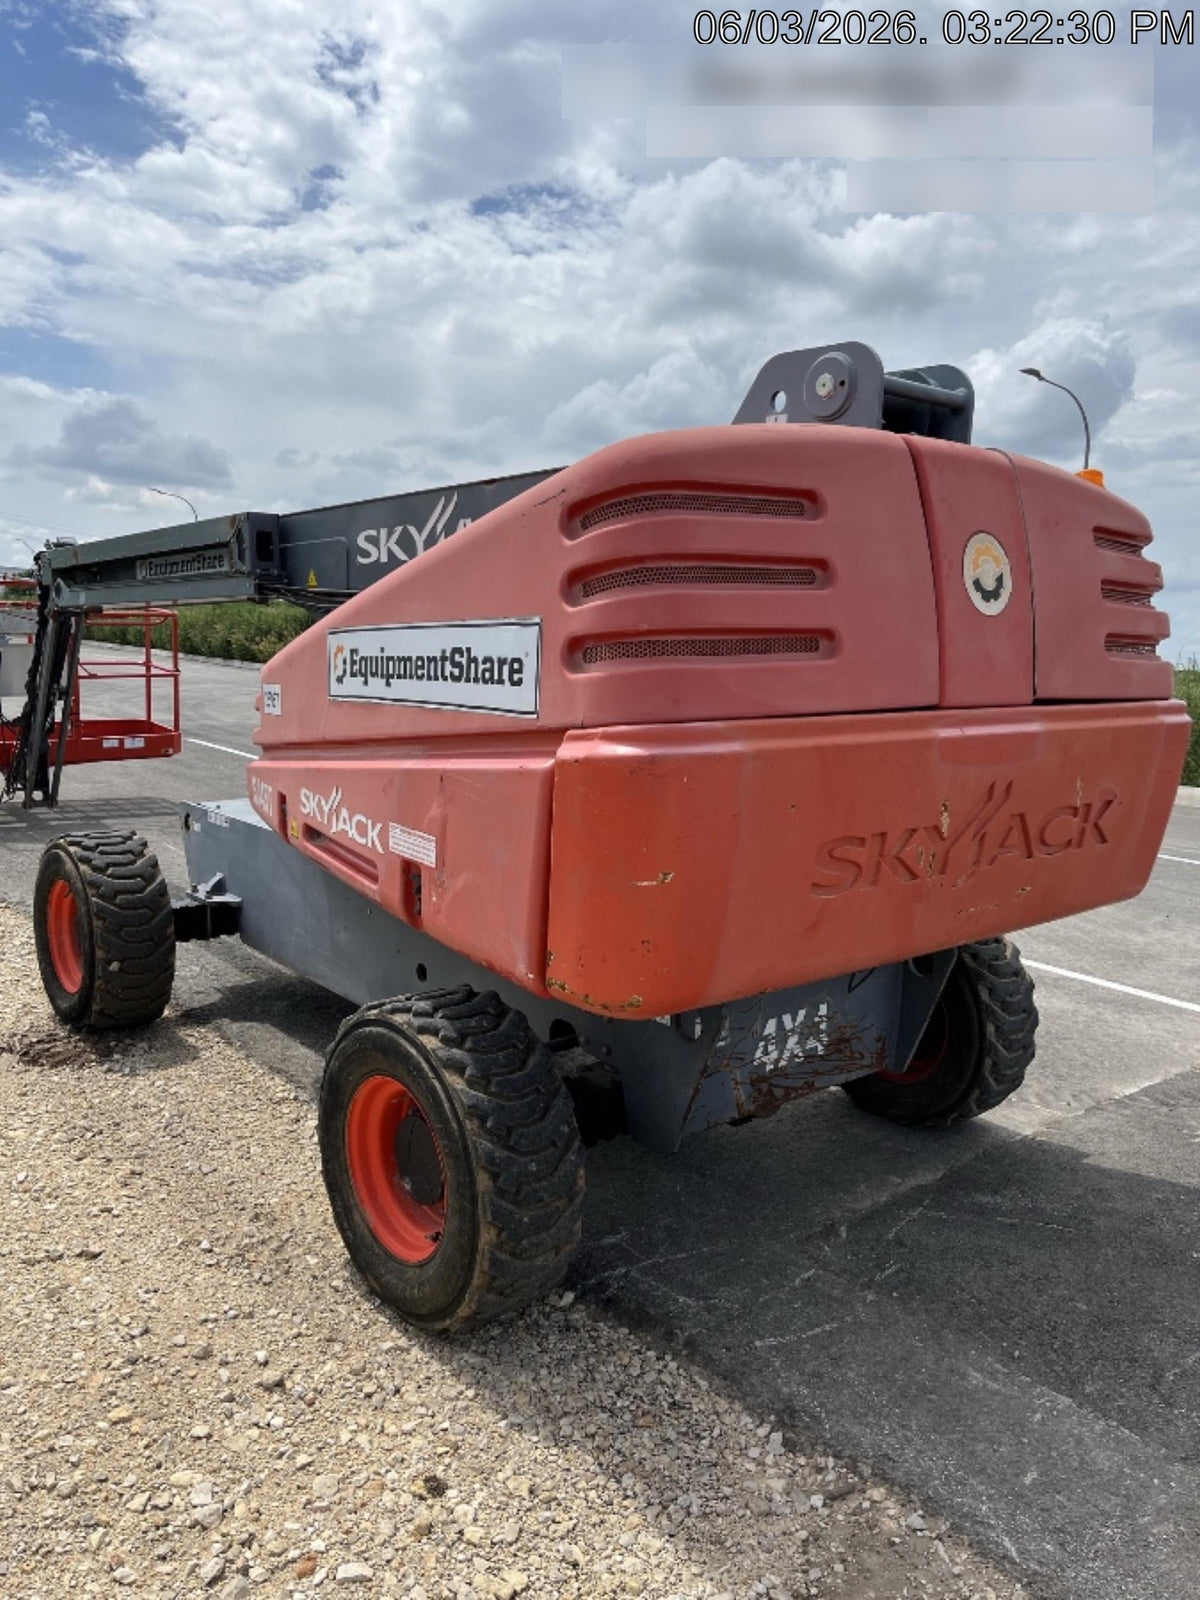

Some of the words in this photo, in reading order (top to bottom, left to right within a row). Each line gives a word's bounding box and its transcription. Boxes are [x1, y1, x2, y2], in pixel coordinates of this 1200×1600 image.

[349, 646, 525, 687] EquipmentShare
[299, 786, 385, 854] SKYJACK
[810, 778, 1118, 898] SKYJACK
